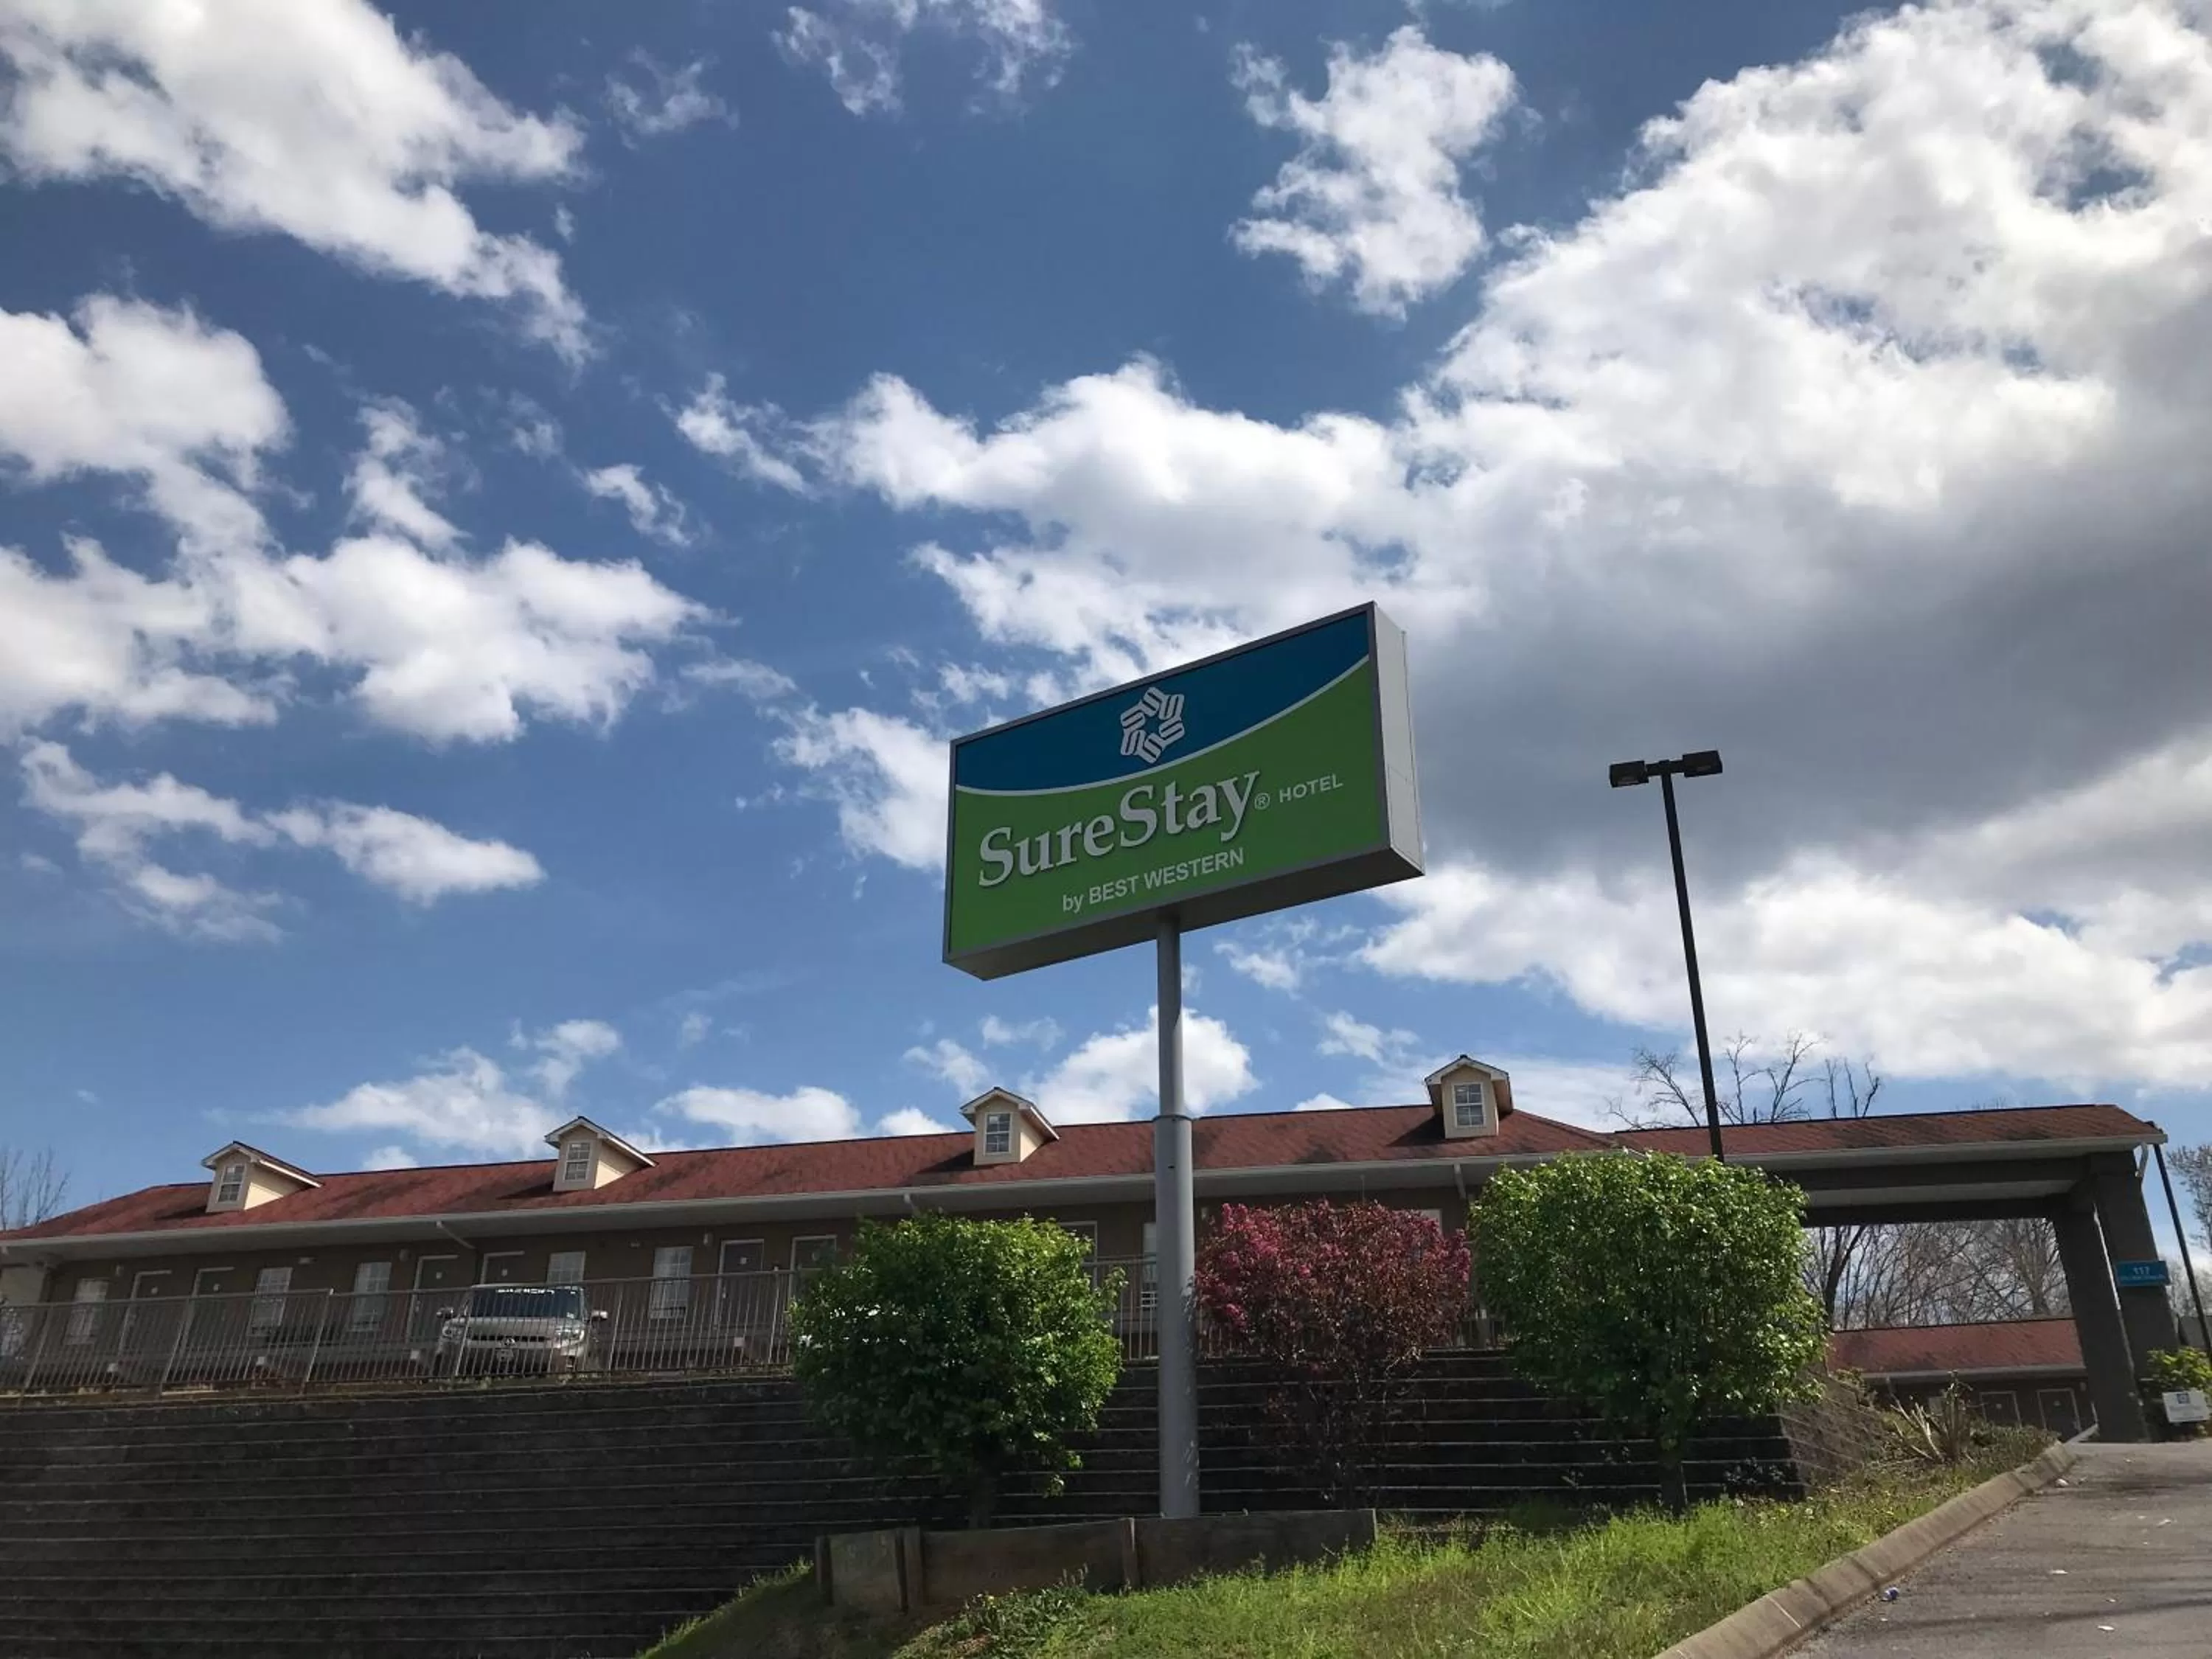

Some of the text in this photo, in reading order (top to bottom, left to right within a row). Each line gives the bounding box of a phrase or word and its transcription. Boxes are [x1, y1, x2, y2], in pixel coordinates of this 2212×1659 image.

[1279, 773, 1343, 803] HOTEL
[1062, 847, 1245, 914] by BEST WESTERN
